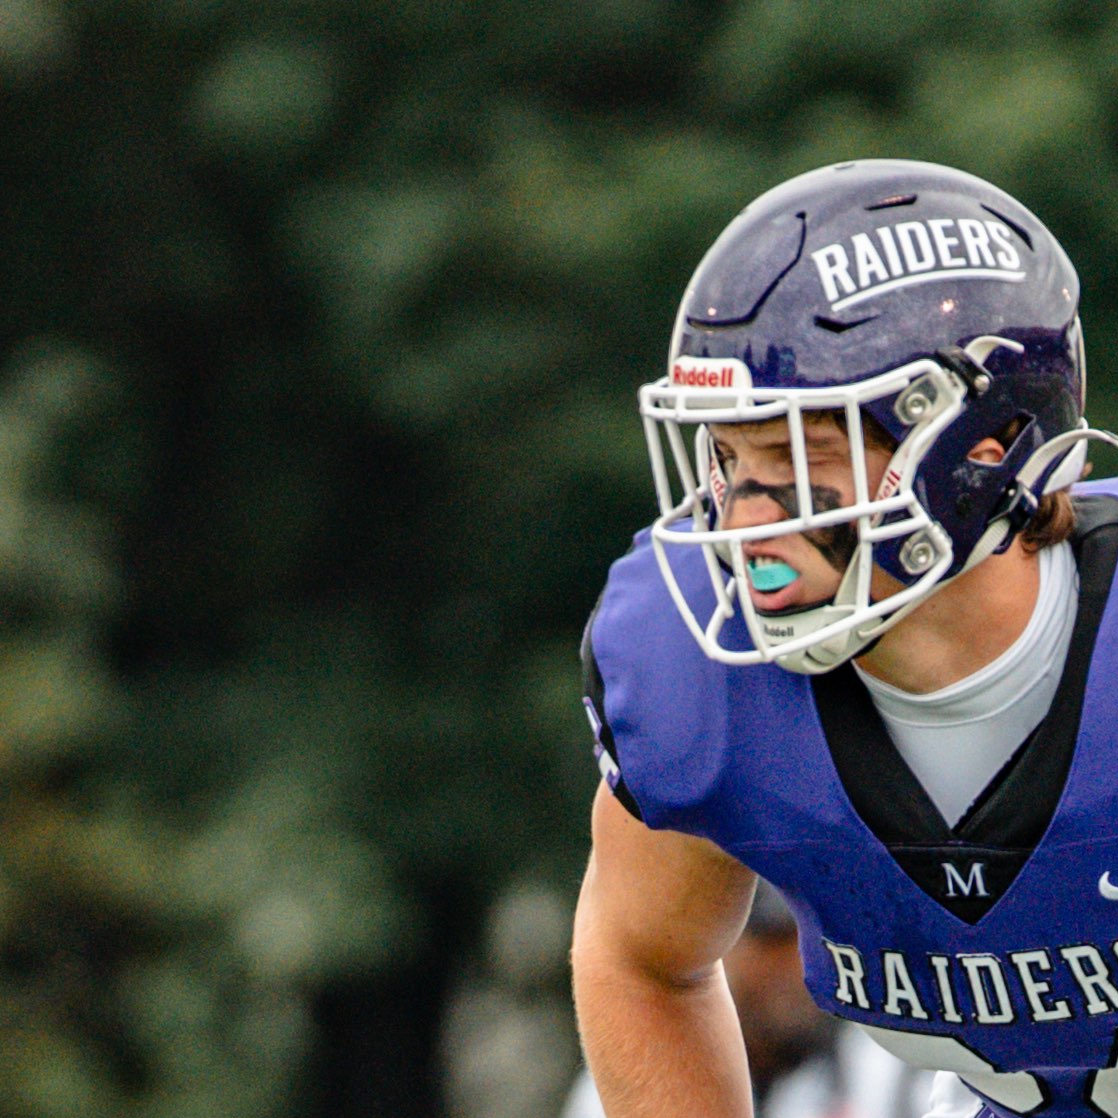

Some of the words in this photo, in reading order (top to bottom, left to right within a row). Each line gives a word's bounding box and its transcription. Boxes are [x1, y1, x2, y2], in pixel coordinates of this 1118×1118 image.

[811, 218, 1020, 302] RAIDERS
[673, 364, 734, 388] Riddell
[945, 862, 991, 898] M
